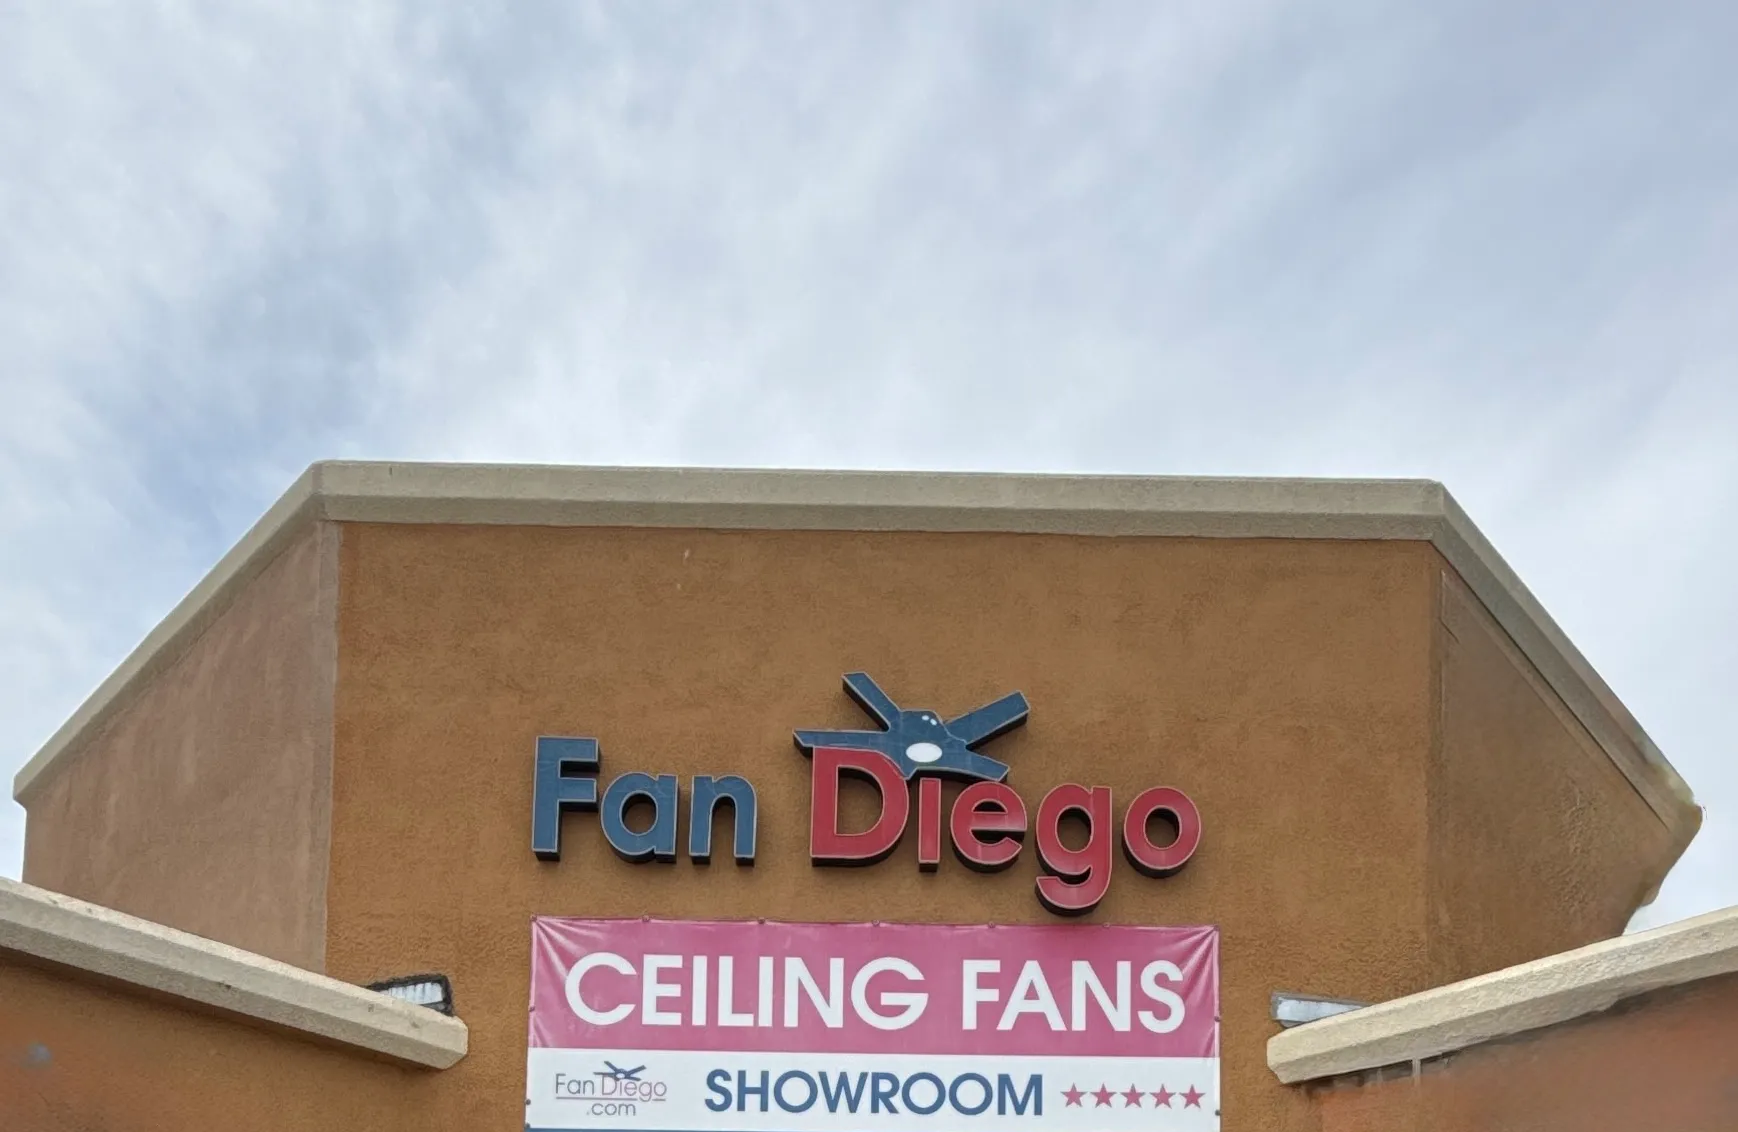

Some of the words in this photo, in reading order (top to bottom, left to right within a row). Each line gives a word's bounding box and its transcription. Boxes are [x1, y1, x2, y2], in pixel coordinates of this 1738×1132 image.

[532, 736, 758, 865] Fan
[809, 746, 1201, 916] Diego
[564, 951, 929, 1030] CEILING
[961, 958, 1186, 1034] FANS
[555, 1073, 595, 1095] Fan
[601, 1075, 668, 1102] Diego
[586, 1103, 637, 1116] .com
[704, 1068, 1044, 1117] SHOWROOM
